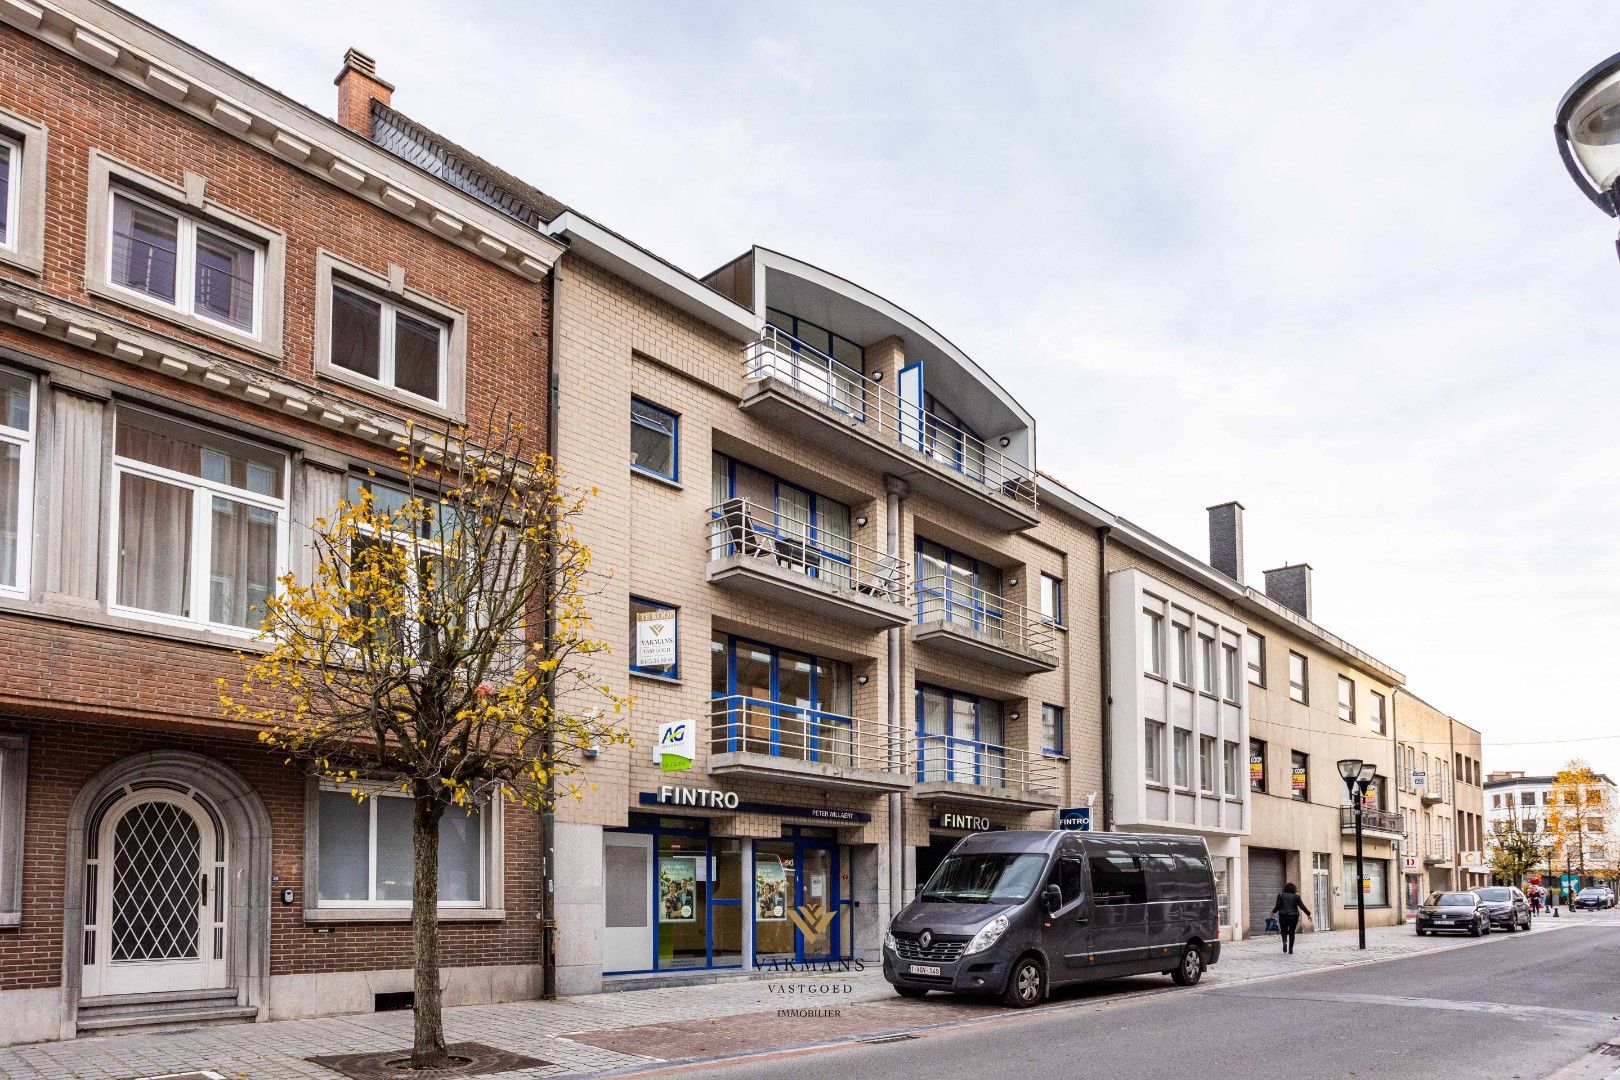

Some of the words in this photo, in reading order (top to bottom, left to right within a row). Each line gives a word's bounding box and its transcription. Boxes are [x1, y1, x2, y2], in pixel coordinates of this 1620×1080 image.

[640, 613, 650, 621] TE
[652, 611, 674, 620] KOOP
[641, 637, 673, 646] VAKMANS
[661, 724, 686, 744] AG
[657, 785, 739, 809] FINTRO
[829, 811, 854, 819] WILLAERT
[943, 813, 990, 831] FINTRO
[1060, 817, 1090, 826] FINTRO
